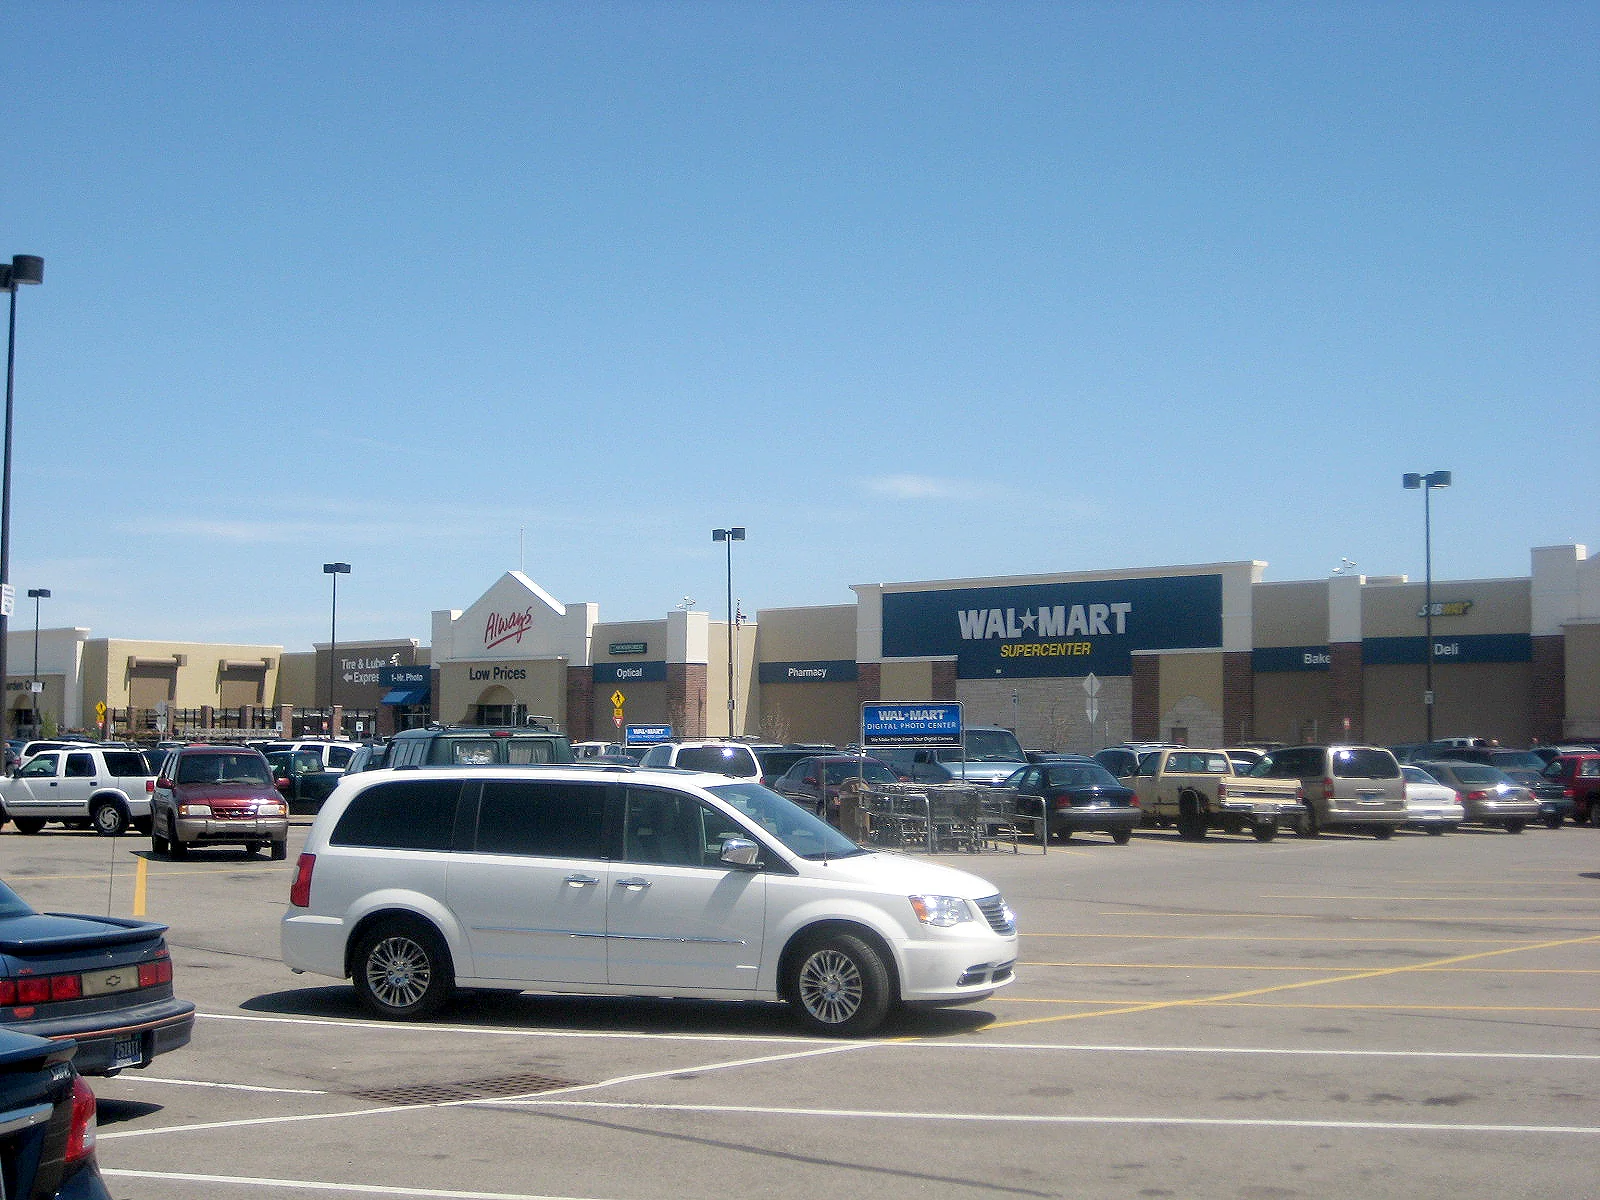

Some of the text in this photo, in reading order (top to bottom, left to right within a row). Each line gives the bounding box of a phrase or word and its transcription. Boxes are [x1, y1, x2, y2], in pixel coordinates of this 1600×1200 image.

[484, 606, 533, 644] Always
[1000, 642, 1092, 657] SUPERCENTER
[1434, 643, 1459, 655] Deli
[341, 658, 386, 670] Tire & Lube
[1304, 653, 1331, 664] Bake
[406, 673, 423, 681] Photo
[469, 666, 527, 680] Low Prices
[616, 668, 643, 679] Optical
[788, 668, 827, 678] Pharmacy
[927, 721, 957, 729] CENTER
